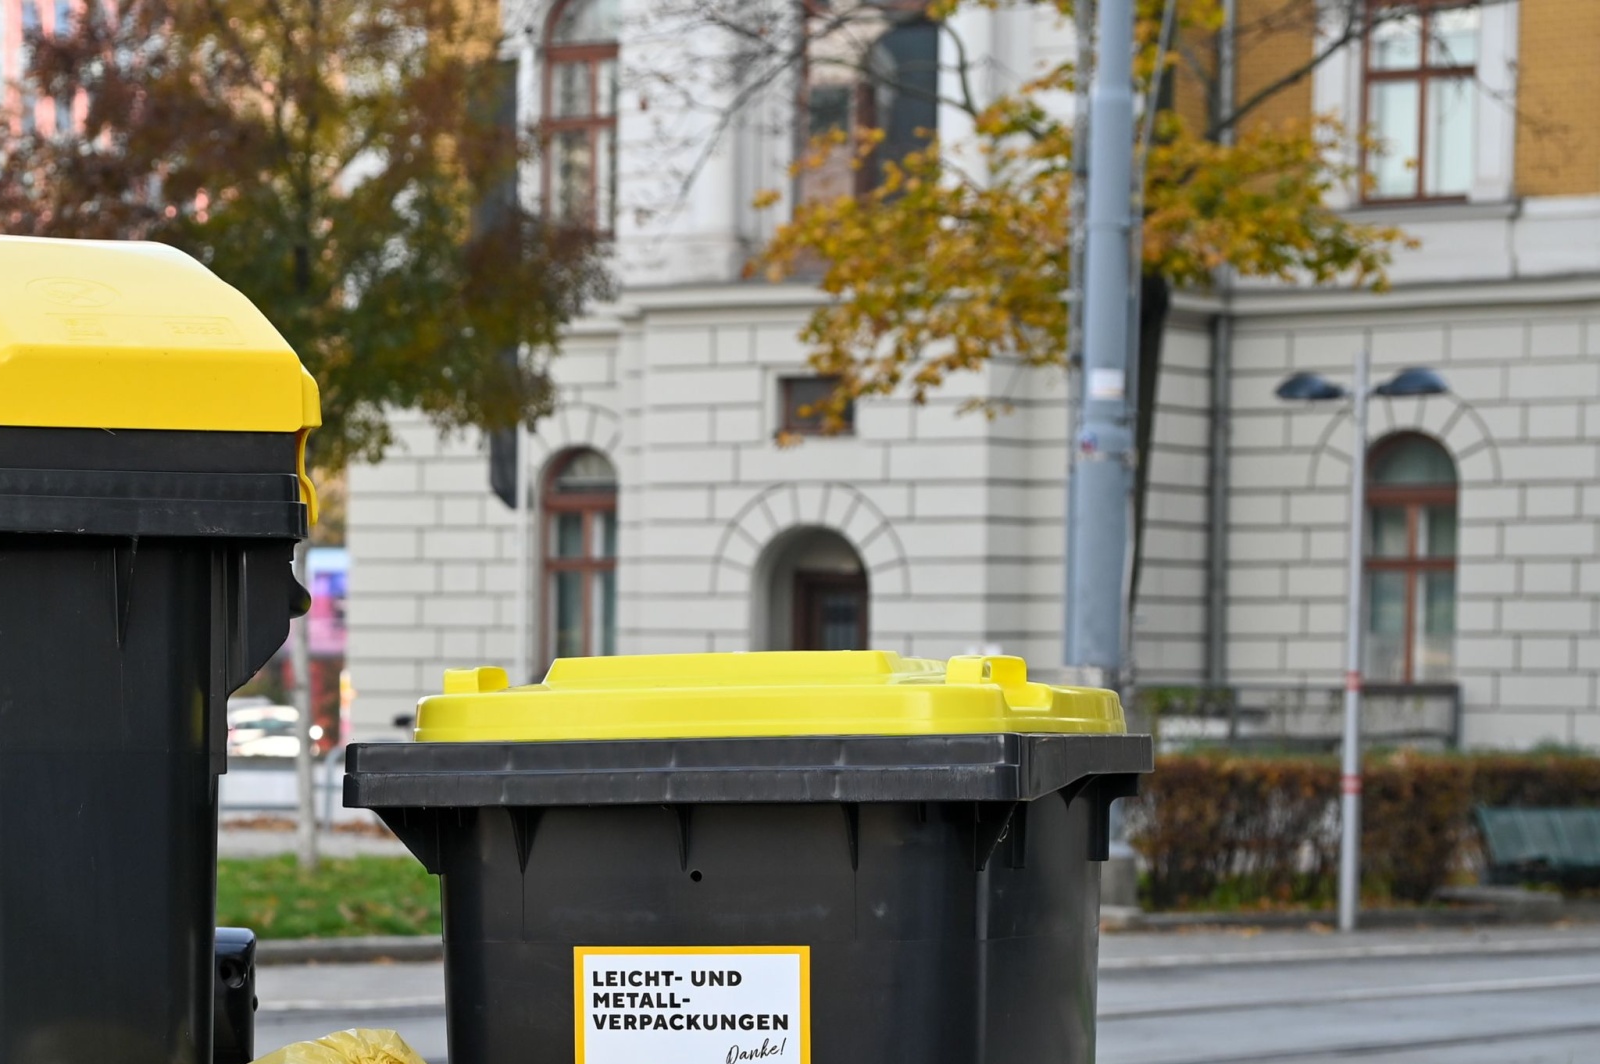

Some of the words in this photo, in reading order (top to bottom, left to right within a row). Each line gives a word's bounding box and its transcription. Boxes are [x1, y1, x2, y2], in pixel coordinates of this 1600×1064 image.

[592, 970, 683, 987] LEICHT-
[690, 970, 742, 987] UND
[592, 992, 691, 1009] METALL-
[592, 1013, 790, 1031] VERPACKUNGEN
